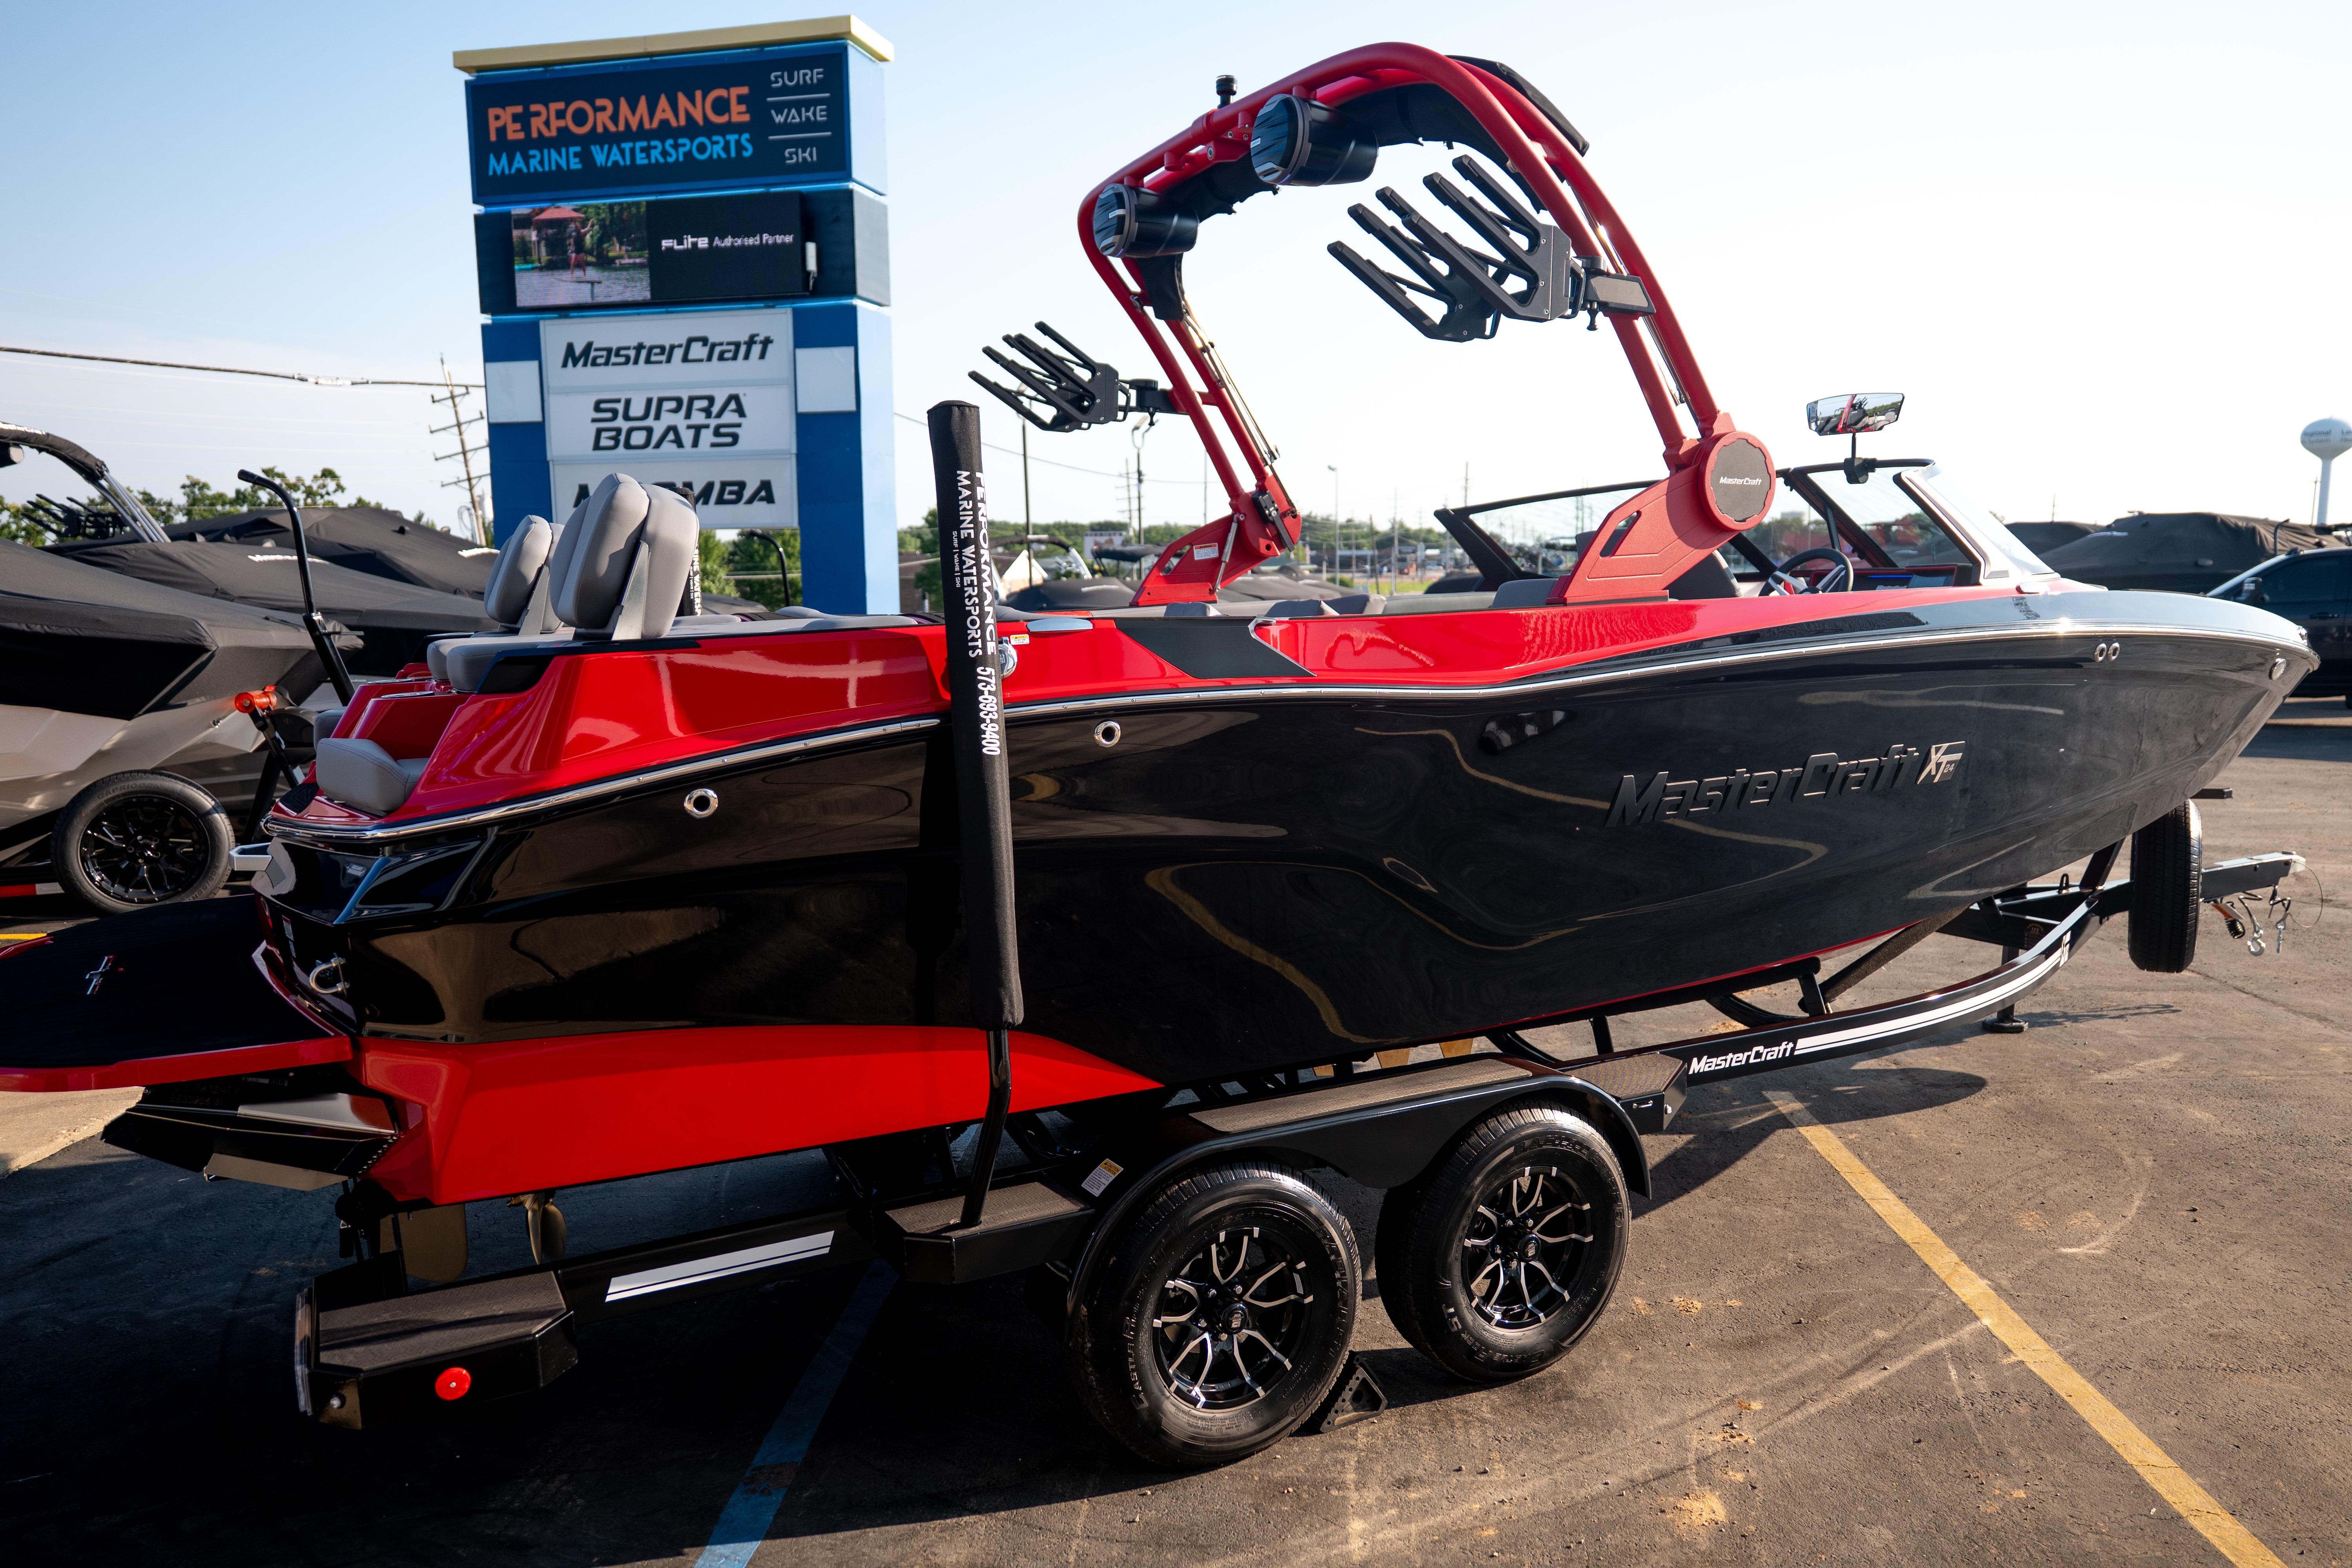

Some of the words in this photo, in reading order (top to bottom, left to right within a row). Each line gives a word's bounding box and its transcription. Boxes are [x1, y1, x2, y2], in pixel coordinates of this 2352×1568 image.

[770, 69, 825, 88] SURF
[488, 86, 751, 142] PERFORMANCE
[770, 105, 828, 124] WAKE
[488, 146, 582, 176] MARINE
[590, 133, 753, 167] WATERSPORTS
[785, 147, 818, 164] SKI
[713, 234, 760, 248] Authorised
[762, 233, 794, 246] Partner
[561, 333, 774, 368] MasterCraft
[591, 394, 747, 422] SUPRA
[592, 423, 742, 451] BOATS
[1719, 476, 1762, 486] MasterCraft
[956, 470, 974, 539] MARINE
[962, 544, 982, 658] WATERSPORTS
[976, 666, 1001, 756] 573-693-9400
[1604, 744, 1919, 827] MasterCraft
[1943, 763, 1955, 773] 24
[1688, 1042, 1794, 1074] MasterCraft
[1107, 1163, 1120, 1172] CAUTION
[1441, 1304, 1462, 1332] ST
